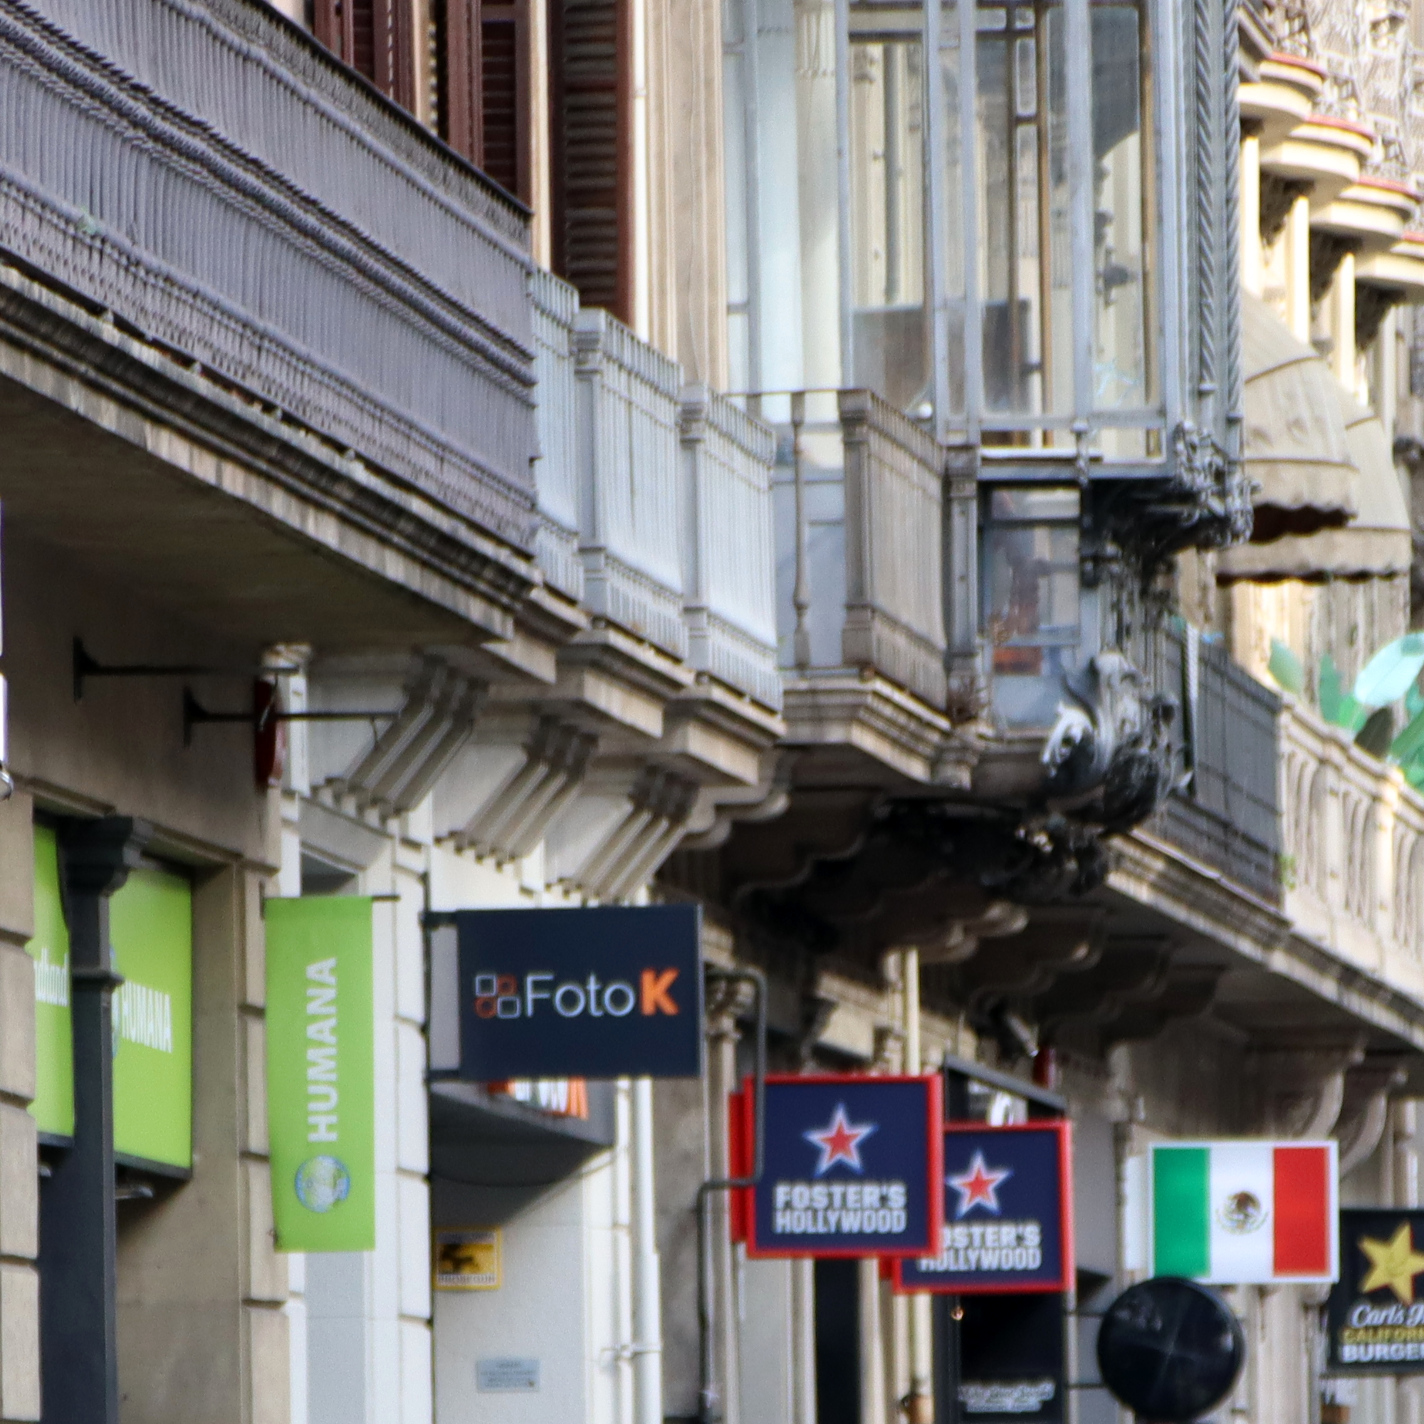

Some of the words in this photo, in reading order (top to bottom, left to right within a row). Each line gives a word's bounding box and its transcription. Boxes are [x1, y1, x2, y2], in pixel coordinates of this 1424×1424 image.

[121, 979, 173, 1054] HUMANA
[307, 957, 338, 1143] HUMANA
[774, 1182, 907, 1210] FOSTER'S
[774, 1209, 907, 1234] HOLLYWOOD
[943, 1222, 1042, 1248] STER'S
